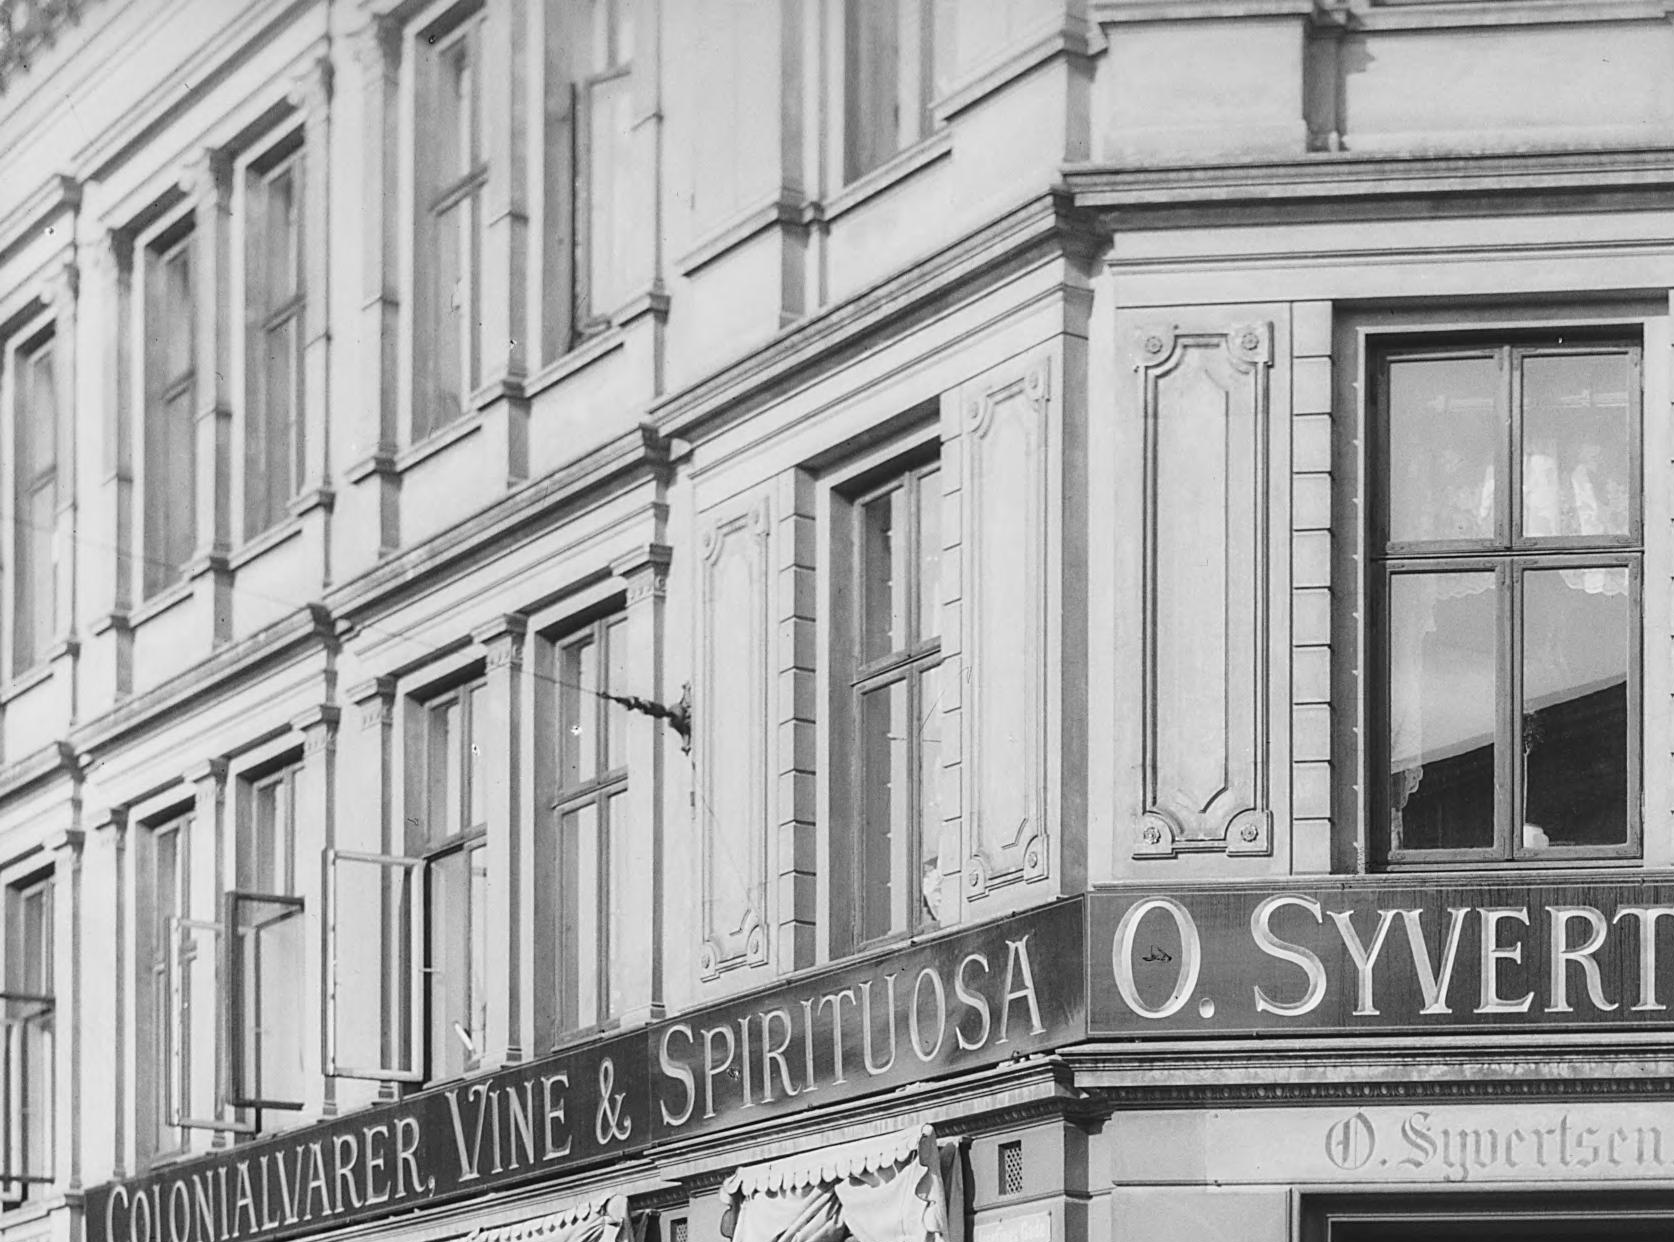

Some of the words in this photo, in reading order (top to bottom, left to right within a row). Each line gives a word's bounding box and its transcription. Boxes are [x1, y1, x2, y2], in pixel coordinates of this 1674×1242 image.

[1113, 894, 1215, 1019] O.
[445, 1072, 574, 1184] VINE
[595, 1055, 632, 1145] &
[658, 934, 1047, 1127] SPIRITUOSA
[1325, 1112, 1389, 1171] O.
